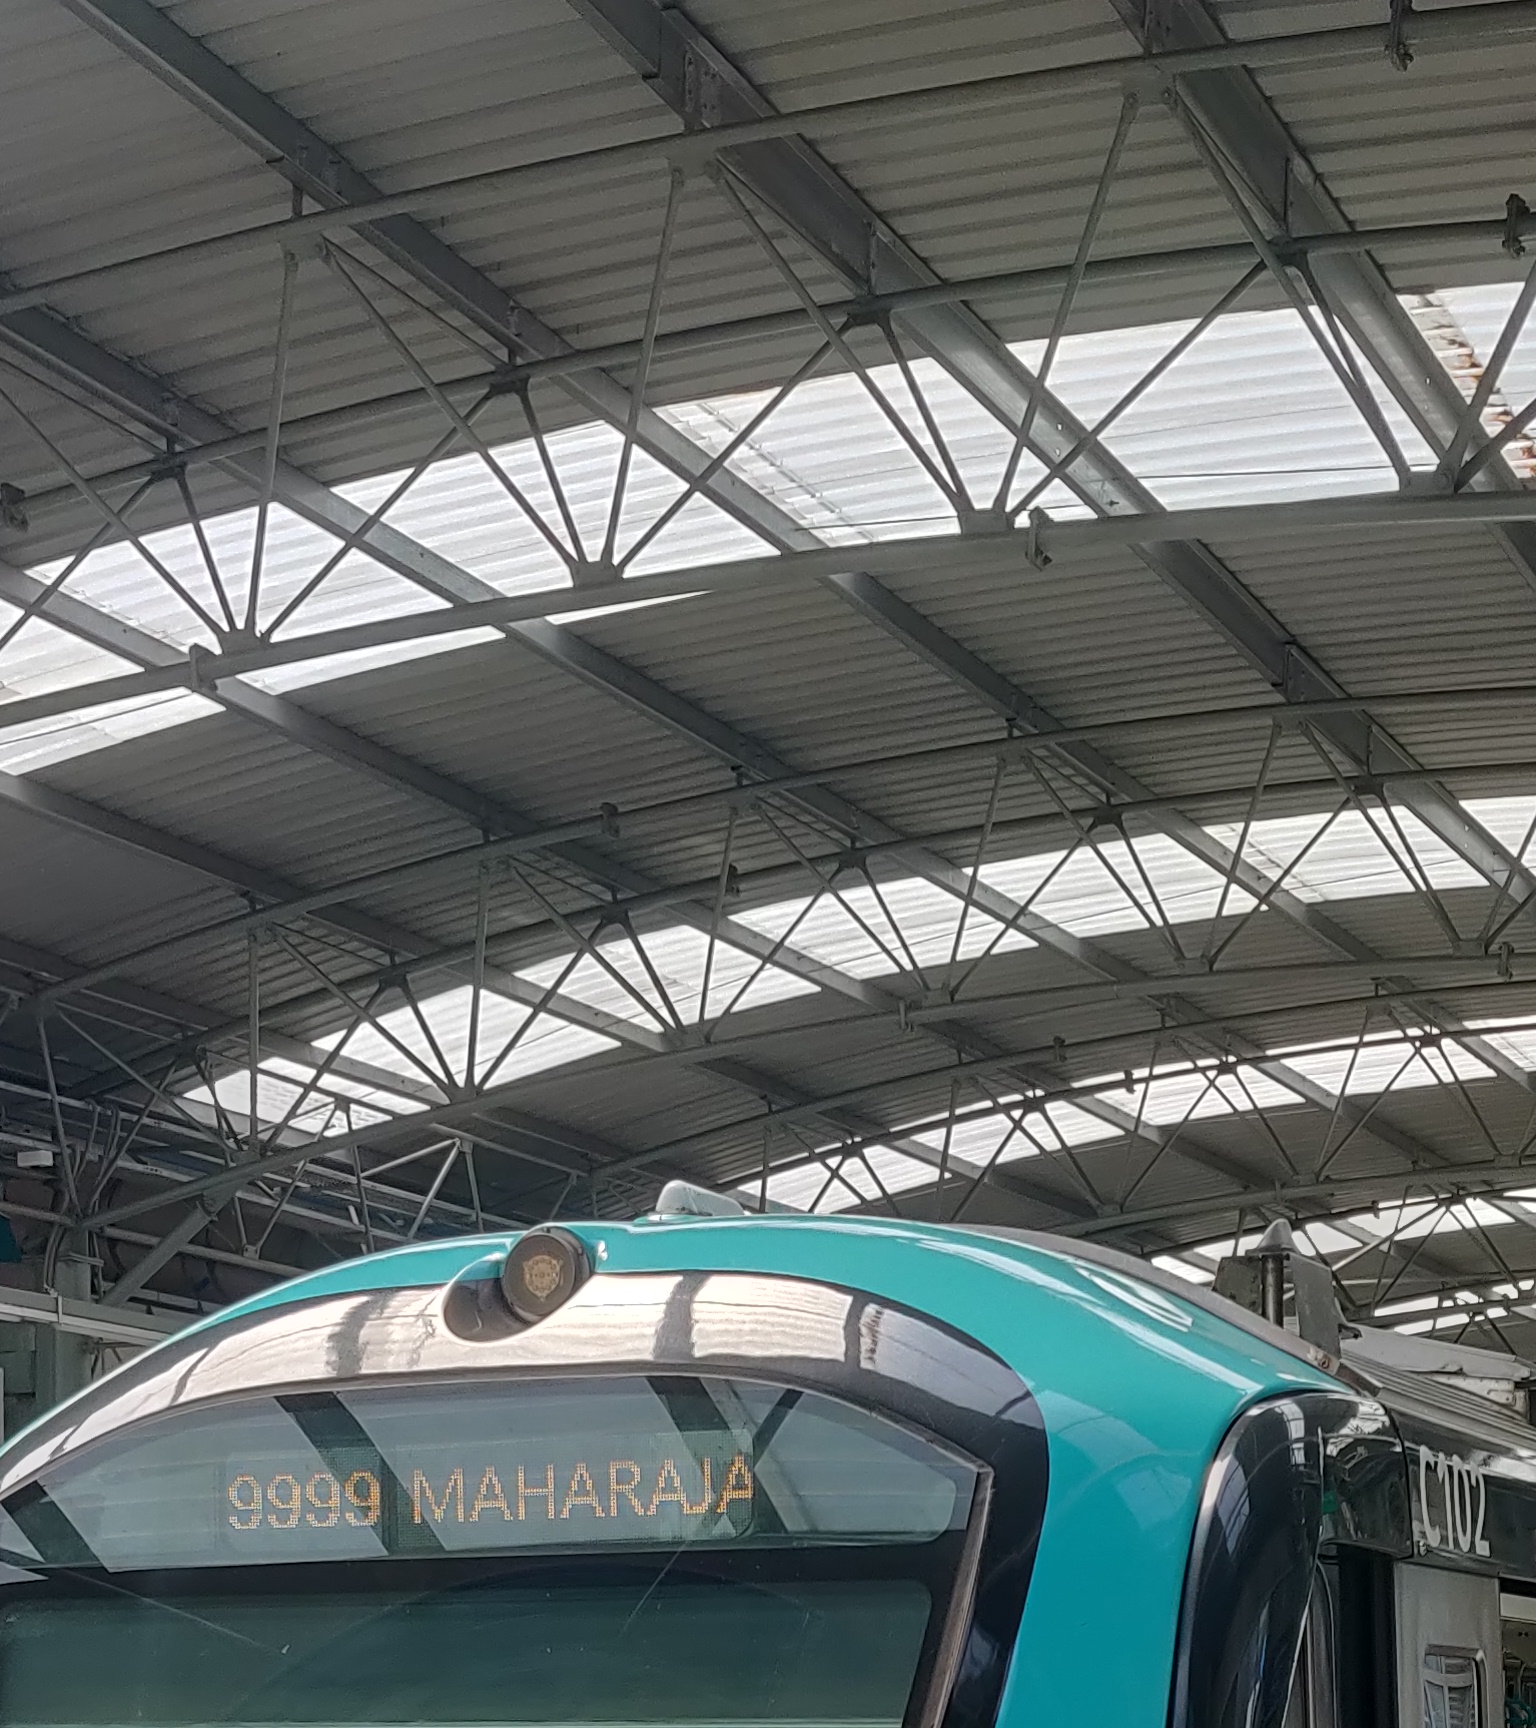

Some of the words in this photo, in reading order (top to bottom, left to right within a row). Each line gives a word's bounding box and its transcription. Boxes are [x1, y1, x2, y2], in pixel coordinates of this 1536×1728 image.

[226, 1468, 382, 1532] 9999
[411, 1453, 758, 1528] MAHARAJA
[1419, 1445, 1492, 1557] C102
